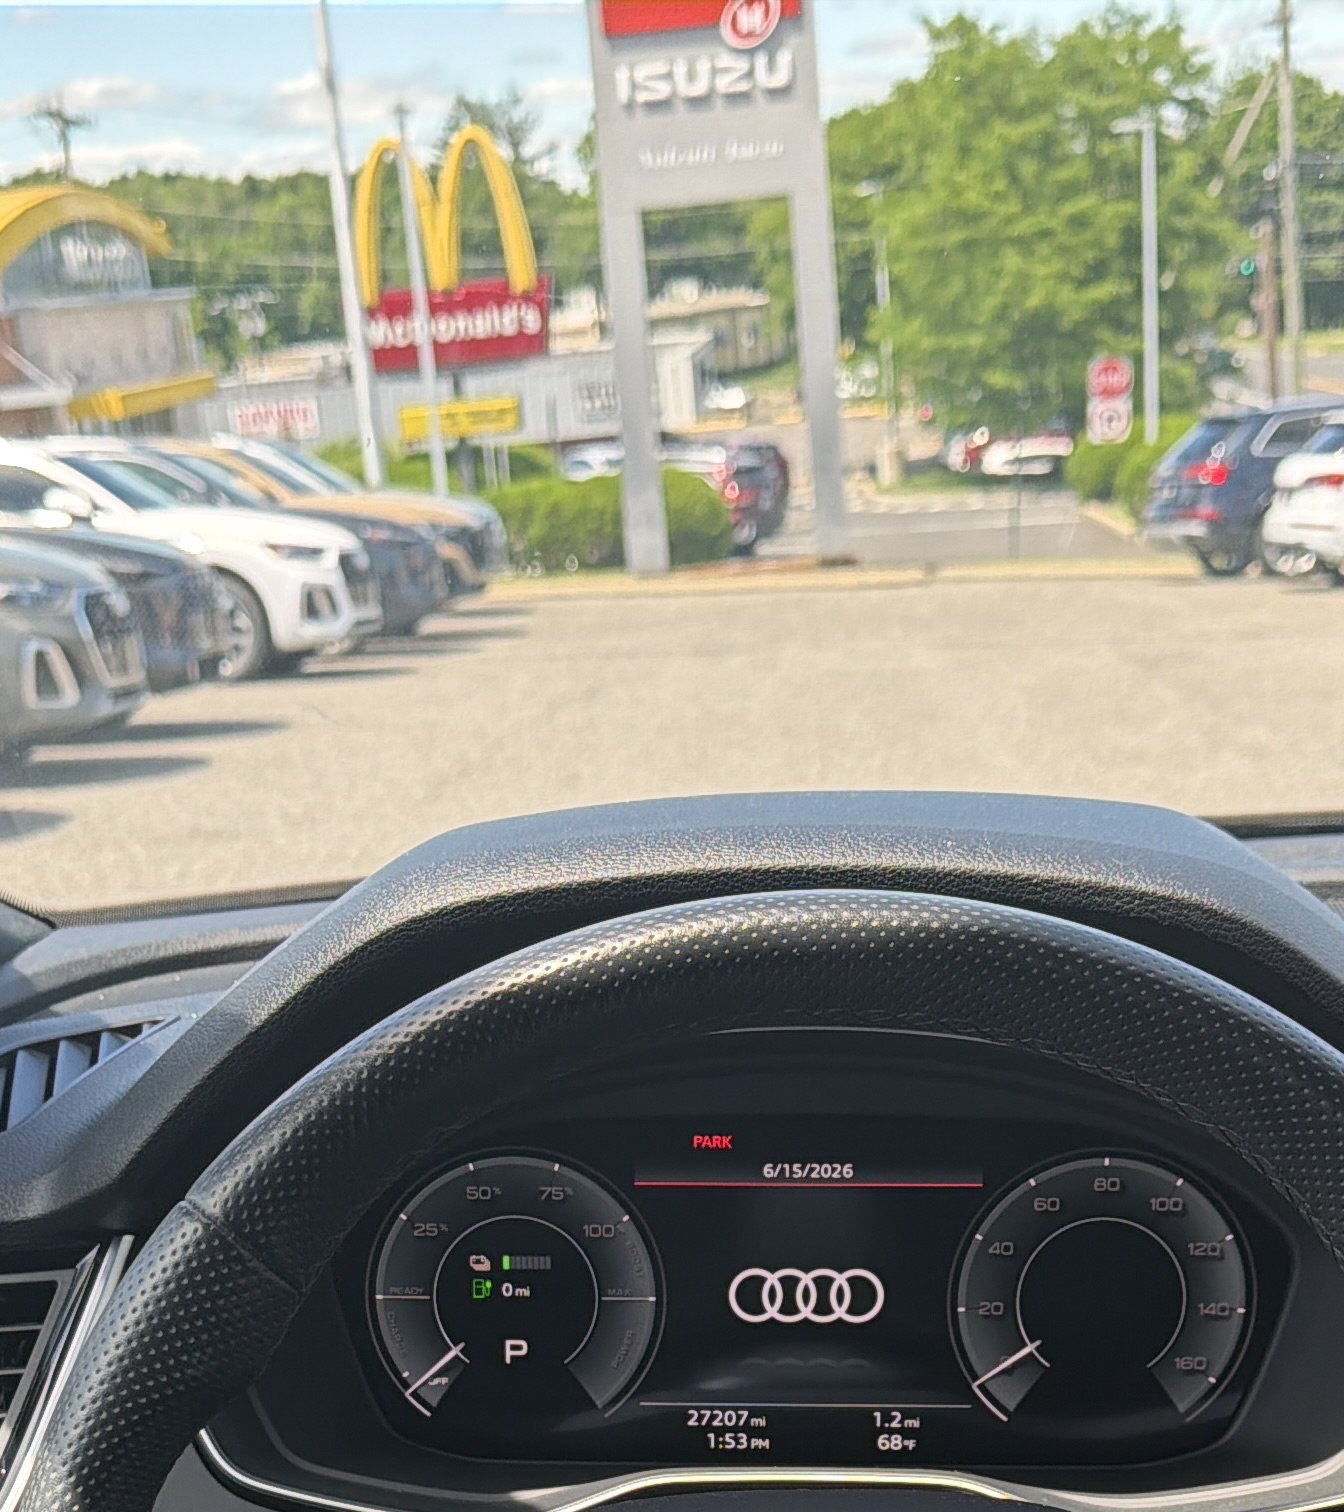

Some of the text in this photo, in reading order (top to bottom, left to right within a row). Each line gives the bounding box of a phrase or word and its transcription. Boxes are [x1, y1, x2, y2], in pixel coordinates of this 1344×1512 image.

[614, 48, 793, 105] ISUZU
[692, 1135, 733, 1149] PARK
[762, 1163, 854, 1179] 6/15/2026
[1094, 1177, 1120, 1192] 80
[466, 1186, 502, 1200] 50%
[540, 1187, 574, 1200] 75%
[1033, 1198, 1060, 1212] 60
[1150, 1198, 1183, 1212] 100
[413, 1223, 449, 1237] 25%
[988, 1242, 1014, 1256] 40
[1187, 1242, 1221, 1256] 120
[501, 1283, 531, 1298] 0 mi
[607, 1288, 632, 1296] MAX
[979, 1302, 1004, 1316] 20
[1198, 1302, 1230, 1316] 140
[504, 1340, 528, 1364] P
[1175, 1356, 1207, 1370] 160
[687, 1410, 766, 1427] 27207 mi
[873, 1411, 921, 1428] 1.2 mi
[707, 1433, 770, 1450] 1:53 PM
